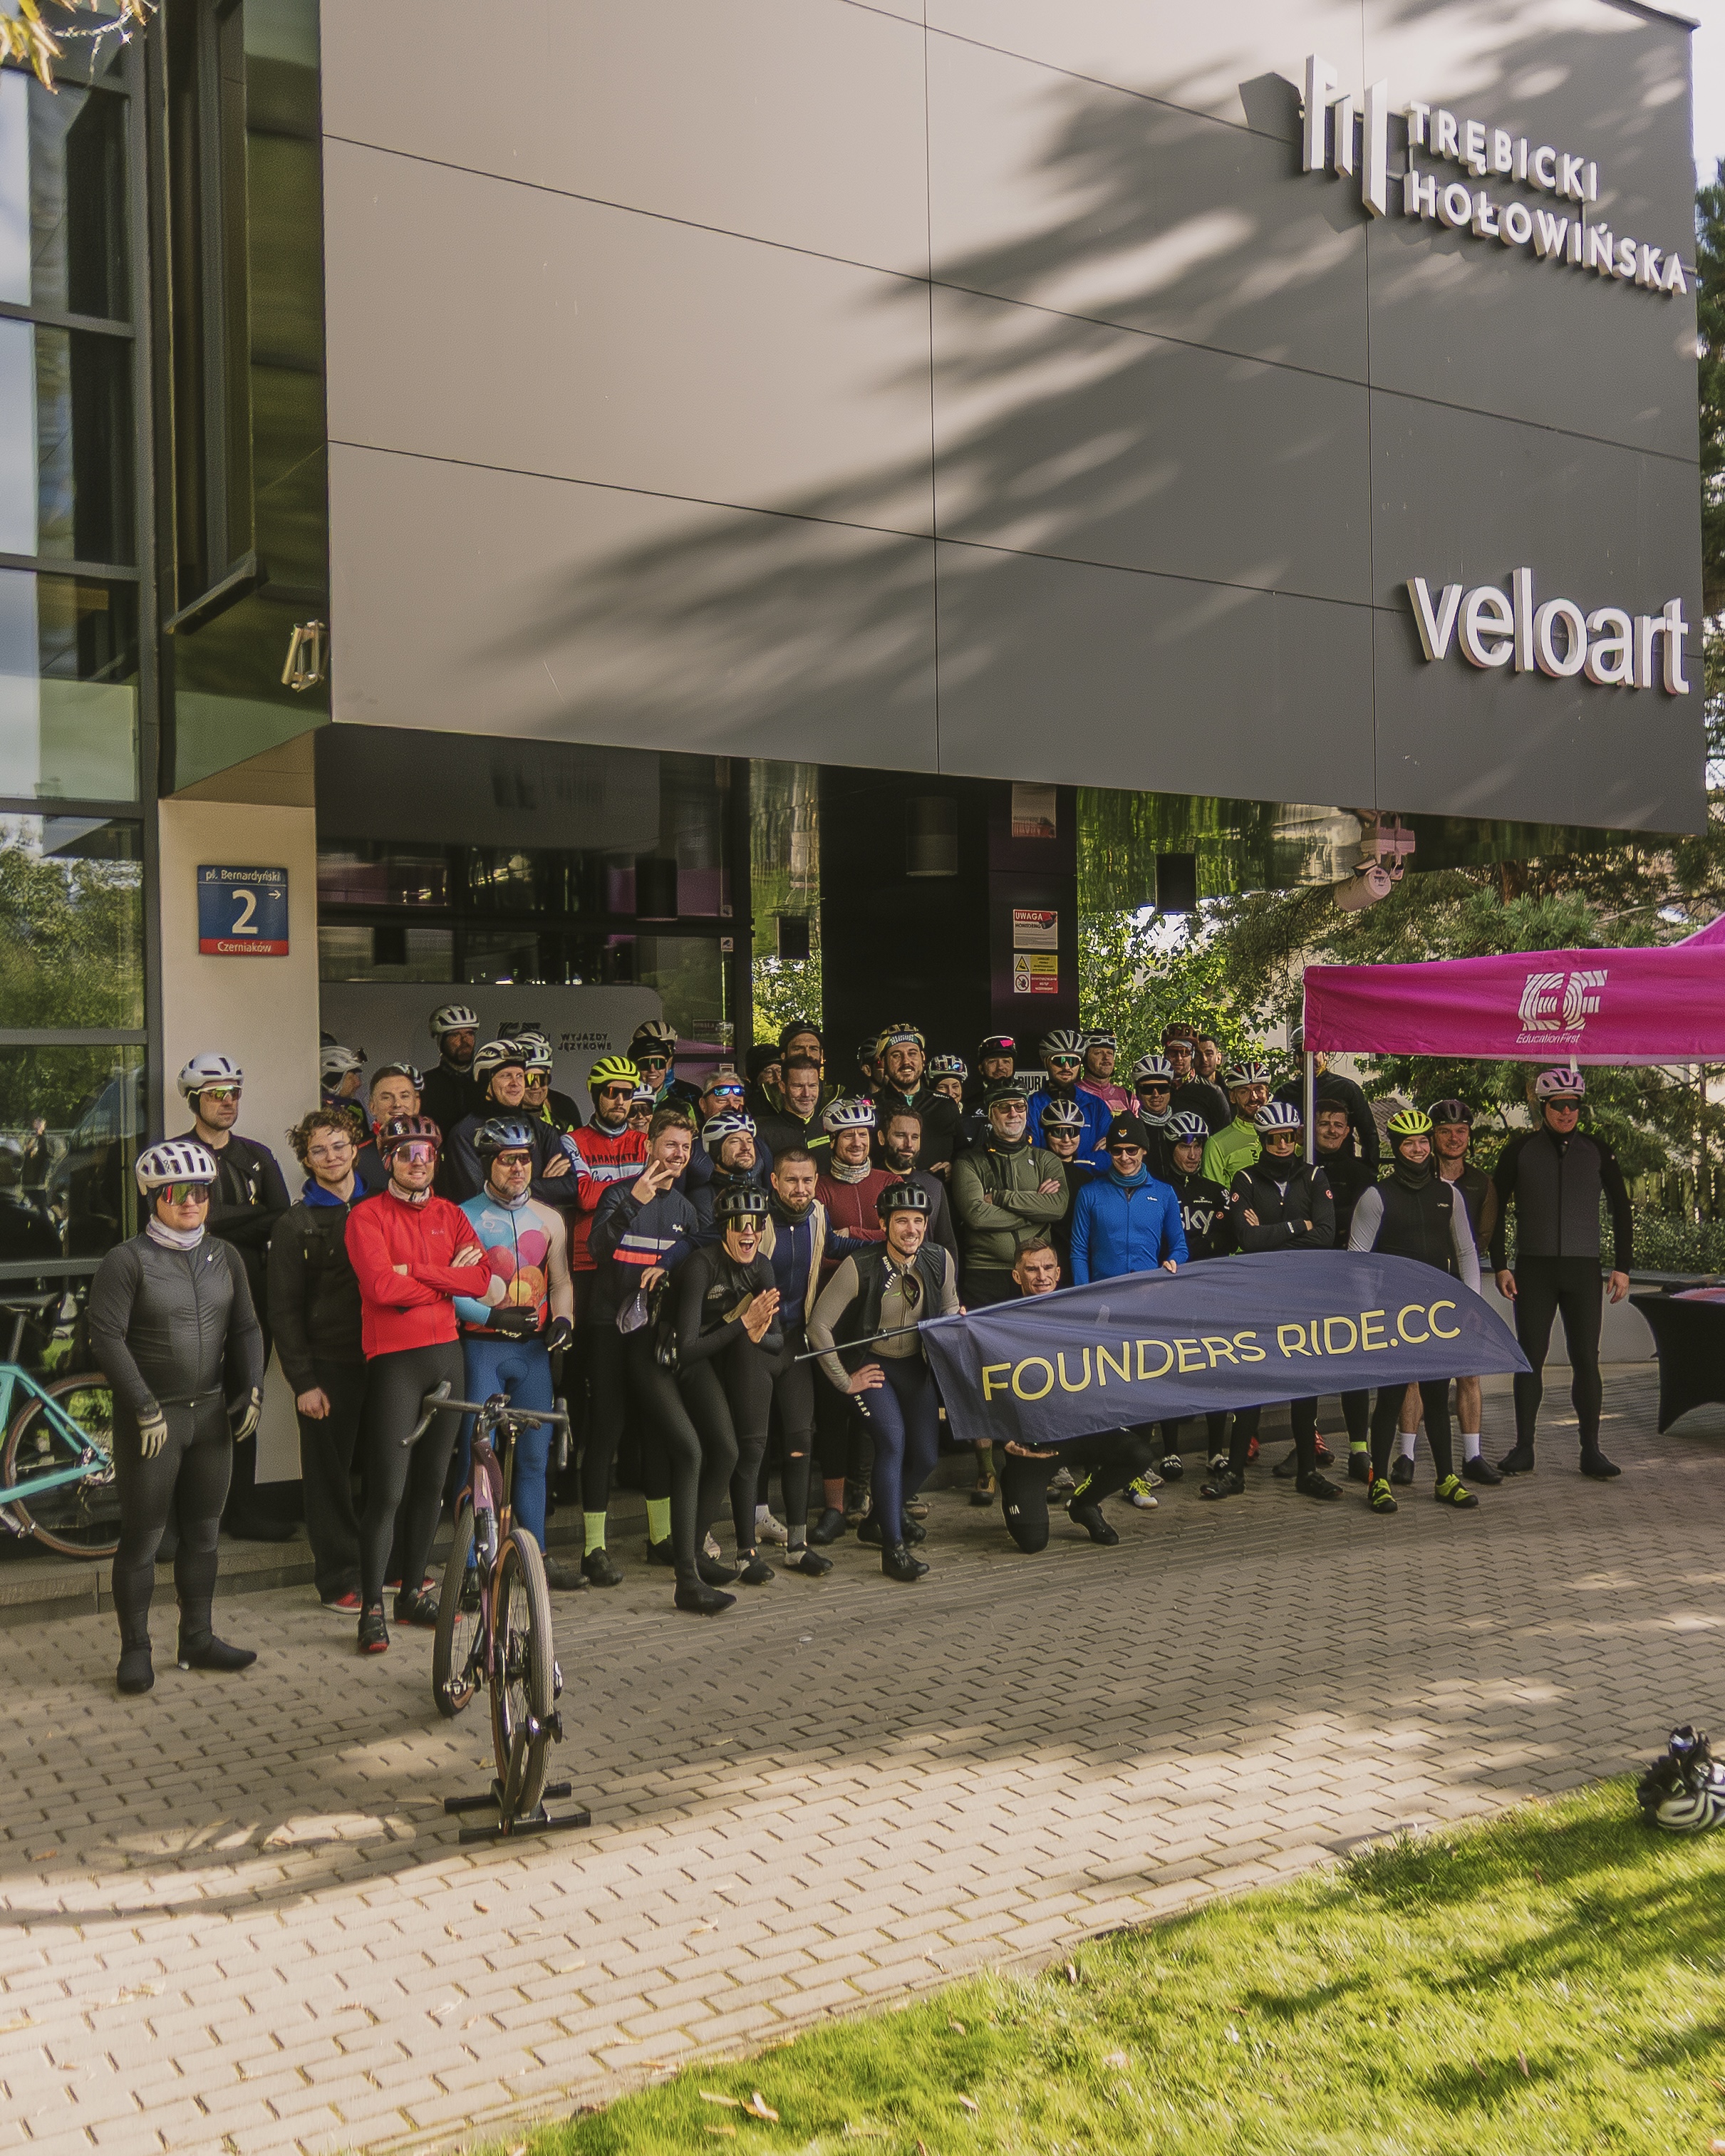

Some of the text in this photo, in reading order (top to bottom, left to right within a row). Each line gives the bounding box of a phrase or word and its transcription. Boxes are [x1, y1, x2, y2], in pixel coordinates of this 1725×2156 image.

[1403, 100, 1598, 202] TRĘBICKI
[1404, 170, 1687, 295] HOŁOWIŃSKA
[1407, 566, 1690, 695] veloart
[221, 869, 281, 883] Bernardyński
[232, 889, 259, 935] 2
[1015, 912, 1043, 921] UWAGA
[217, 941, 272, 953] Czerniaków
[1518, 970, 1608, 1032] EF
[557, 1042, 612, 1052] JĘZYKOWE
[561, 1032, 608, 1041] WYJAZDY
[982, 1300, 1462, 1401] FOUNDERS RIDE.CC
